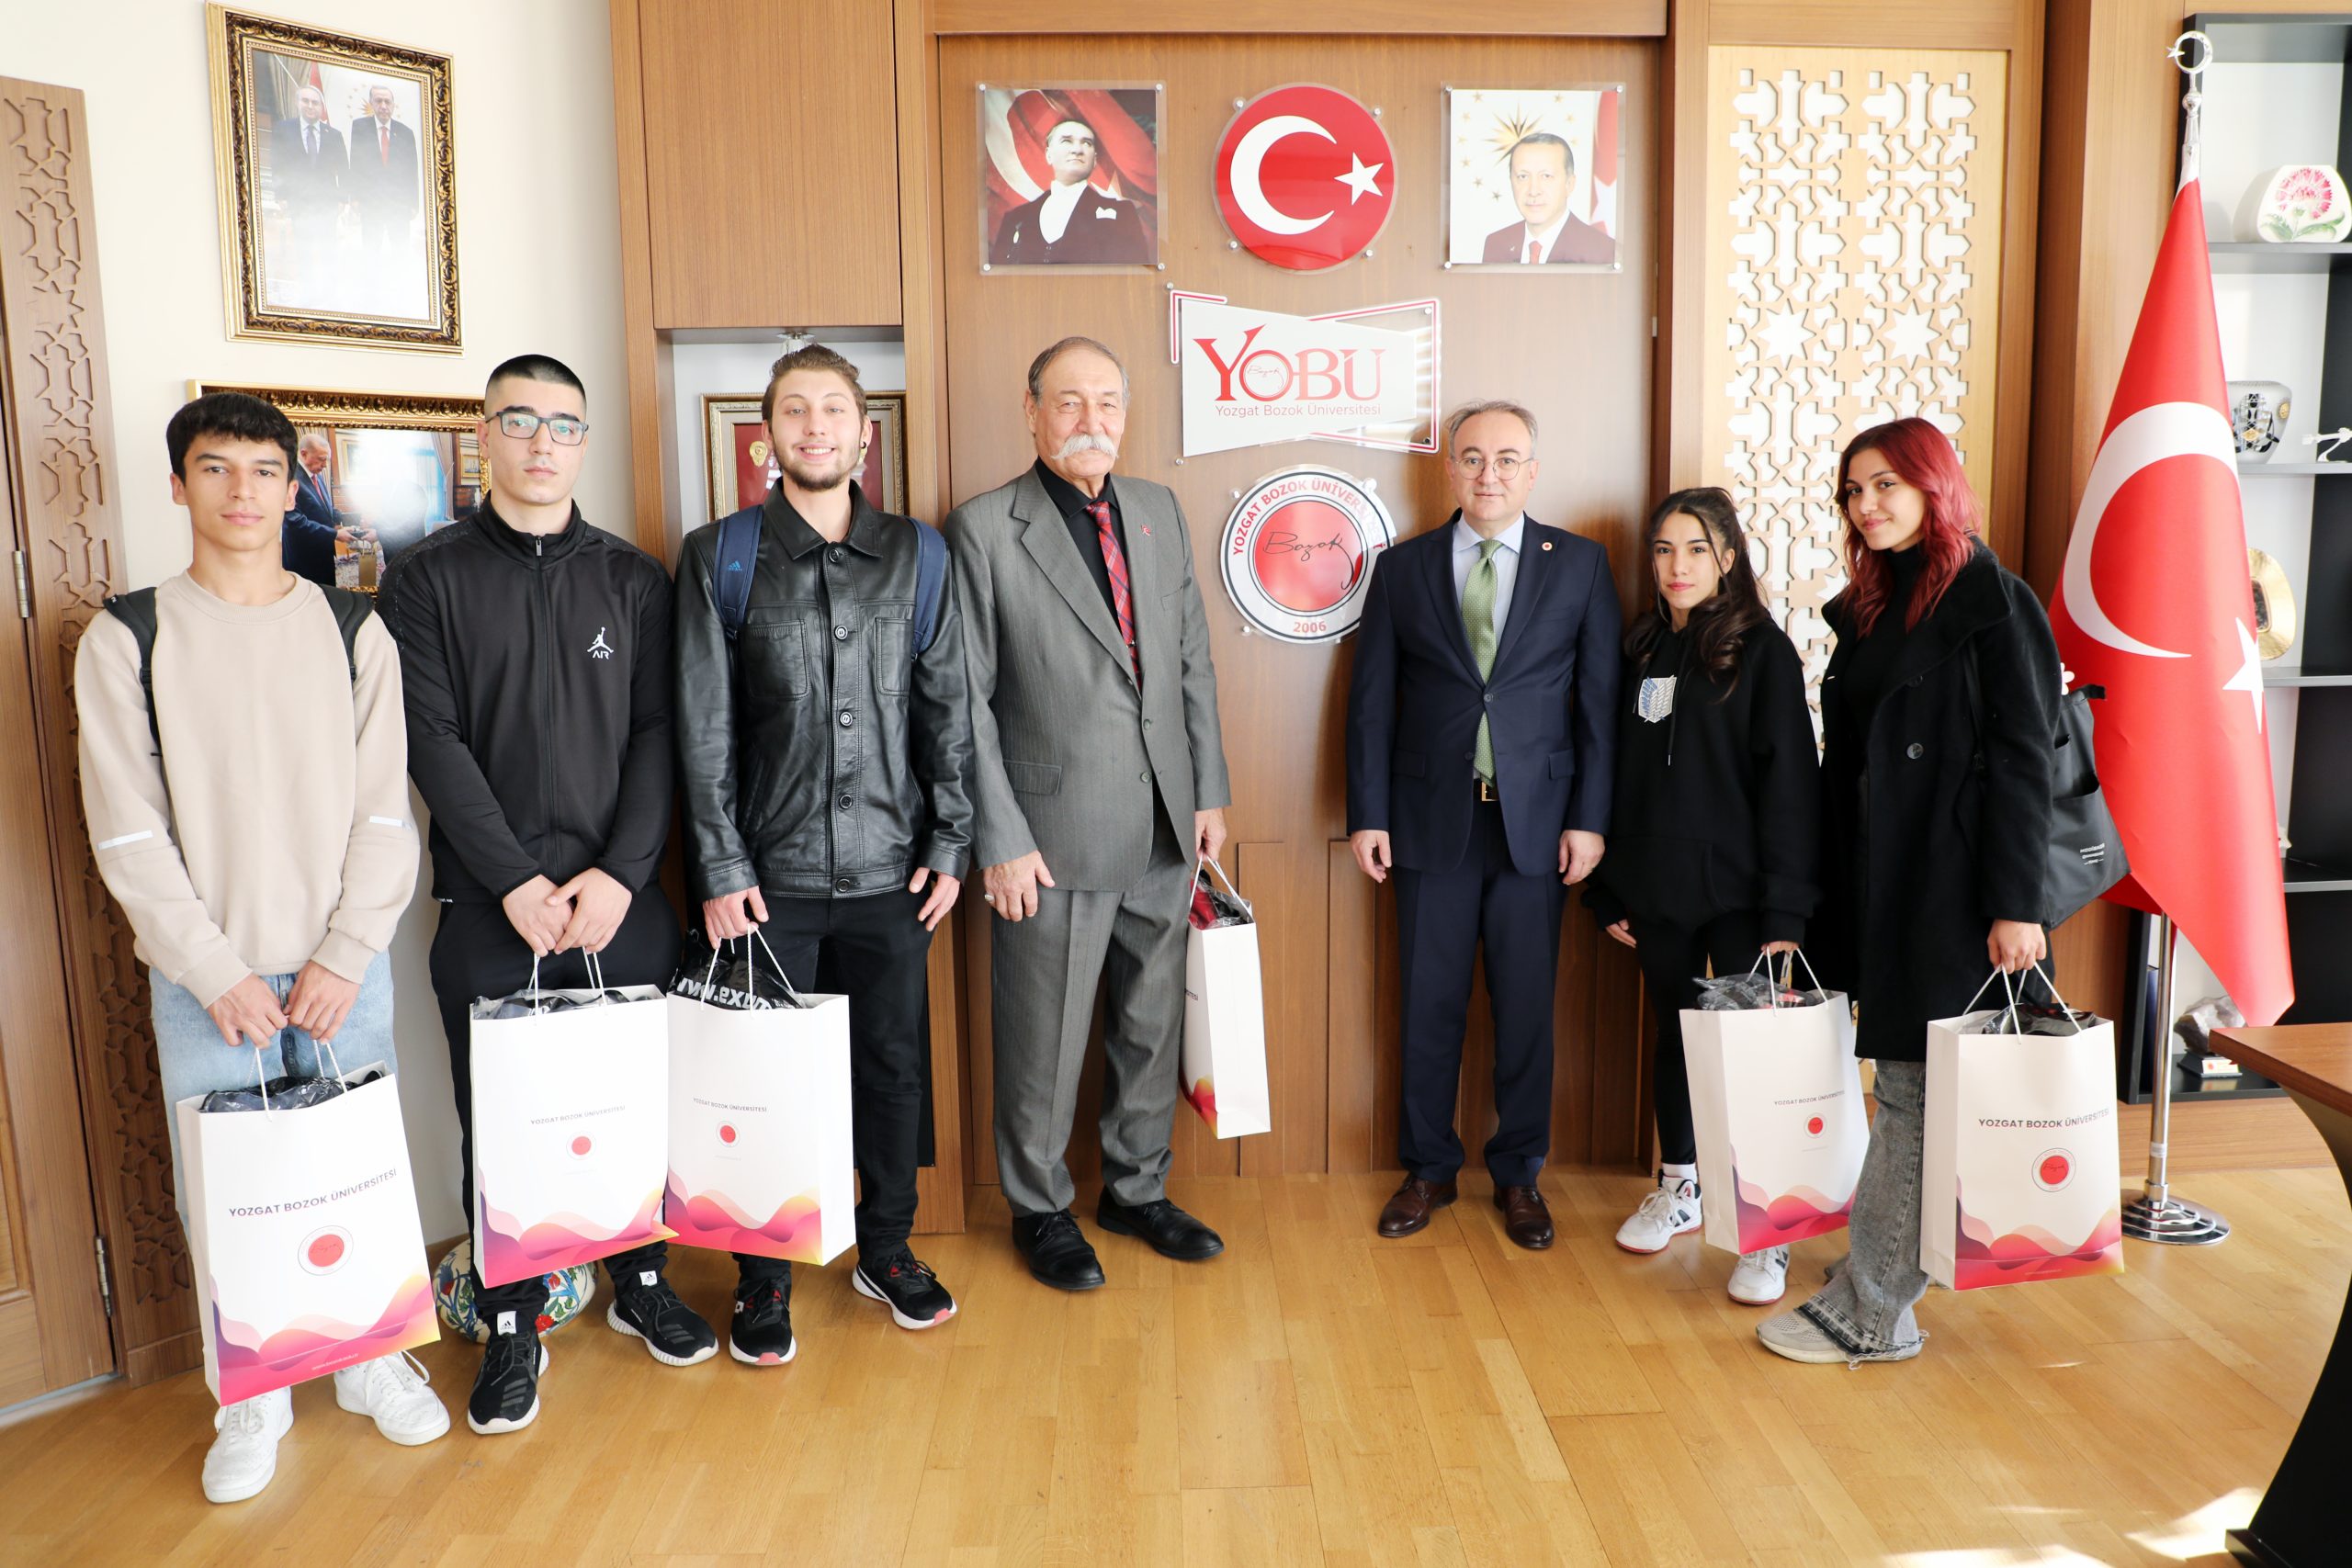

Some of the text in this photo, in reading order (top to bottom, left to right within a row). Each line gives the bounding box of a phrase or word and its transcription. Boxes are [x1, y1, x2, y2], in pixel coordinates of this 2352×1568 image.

[1216, 402, 1381, 418] Yozgat Bozok Üniversitesi
[1233, 502, 1261, 555] YOZGAT
[1261, 479, 1306, 506] BOZOK
[1262, 531, 1355, 591] Bozok
[1293, 621, 1328, 634] 2006
[592, 649, 609, 660] AIR
[710, 1101, 729, 1110] BOZOK
[1978, 1119, 2024, 1128] YOZGAT
[2026, 1120, 2063, 1129] BOZOK
[229, 1168, 398, 1217] YOZGAT BOZOK ÜNİVERSİTESİ
